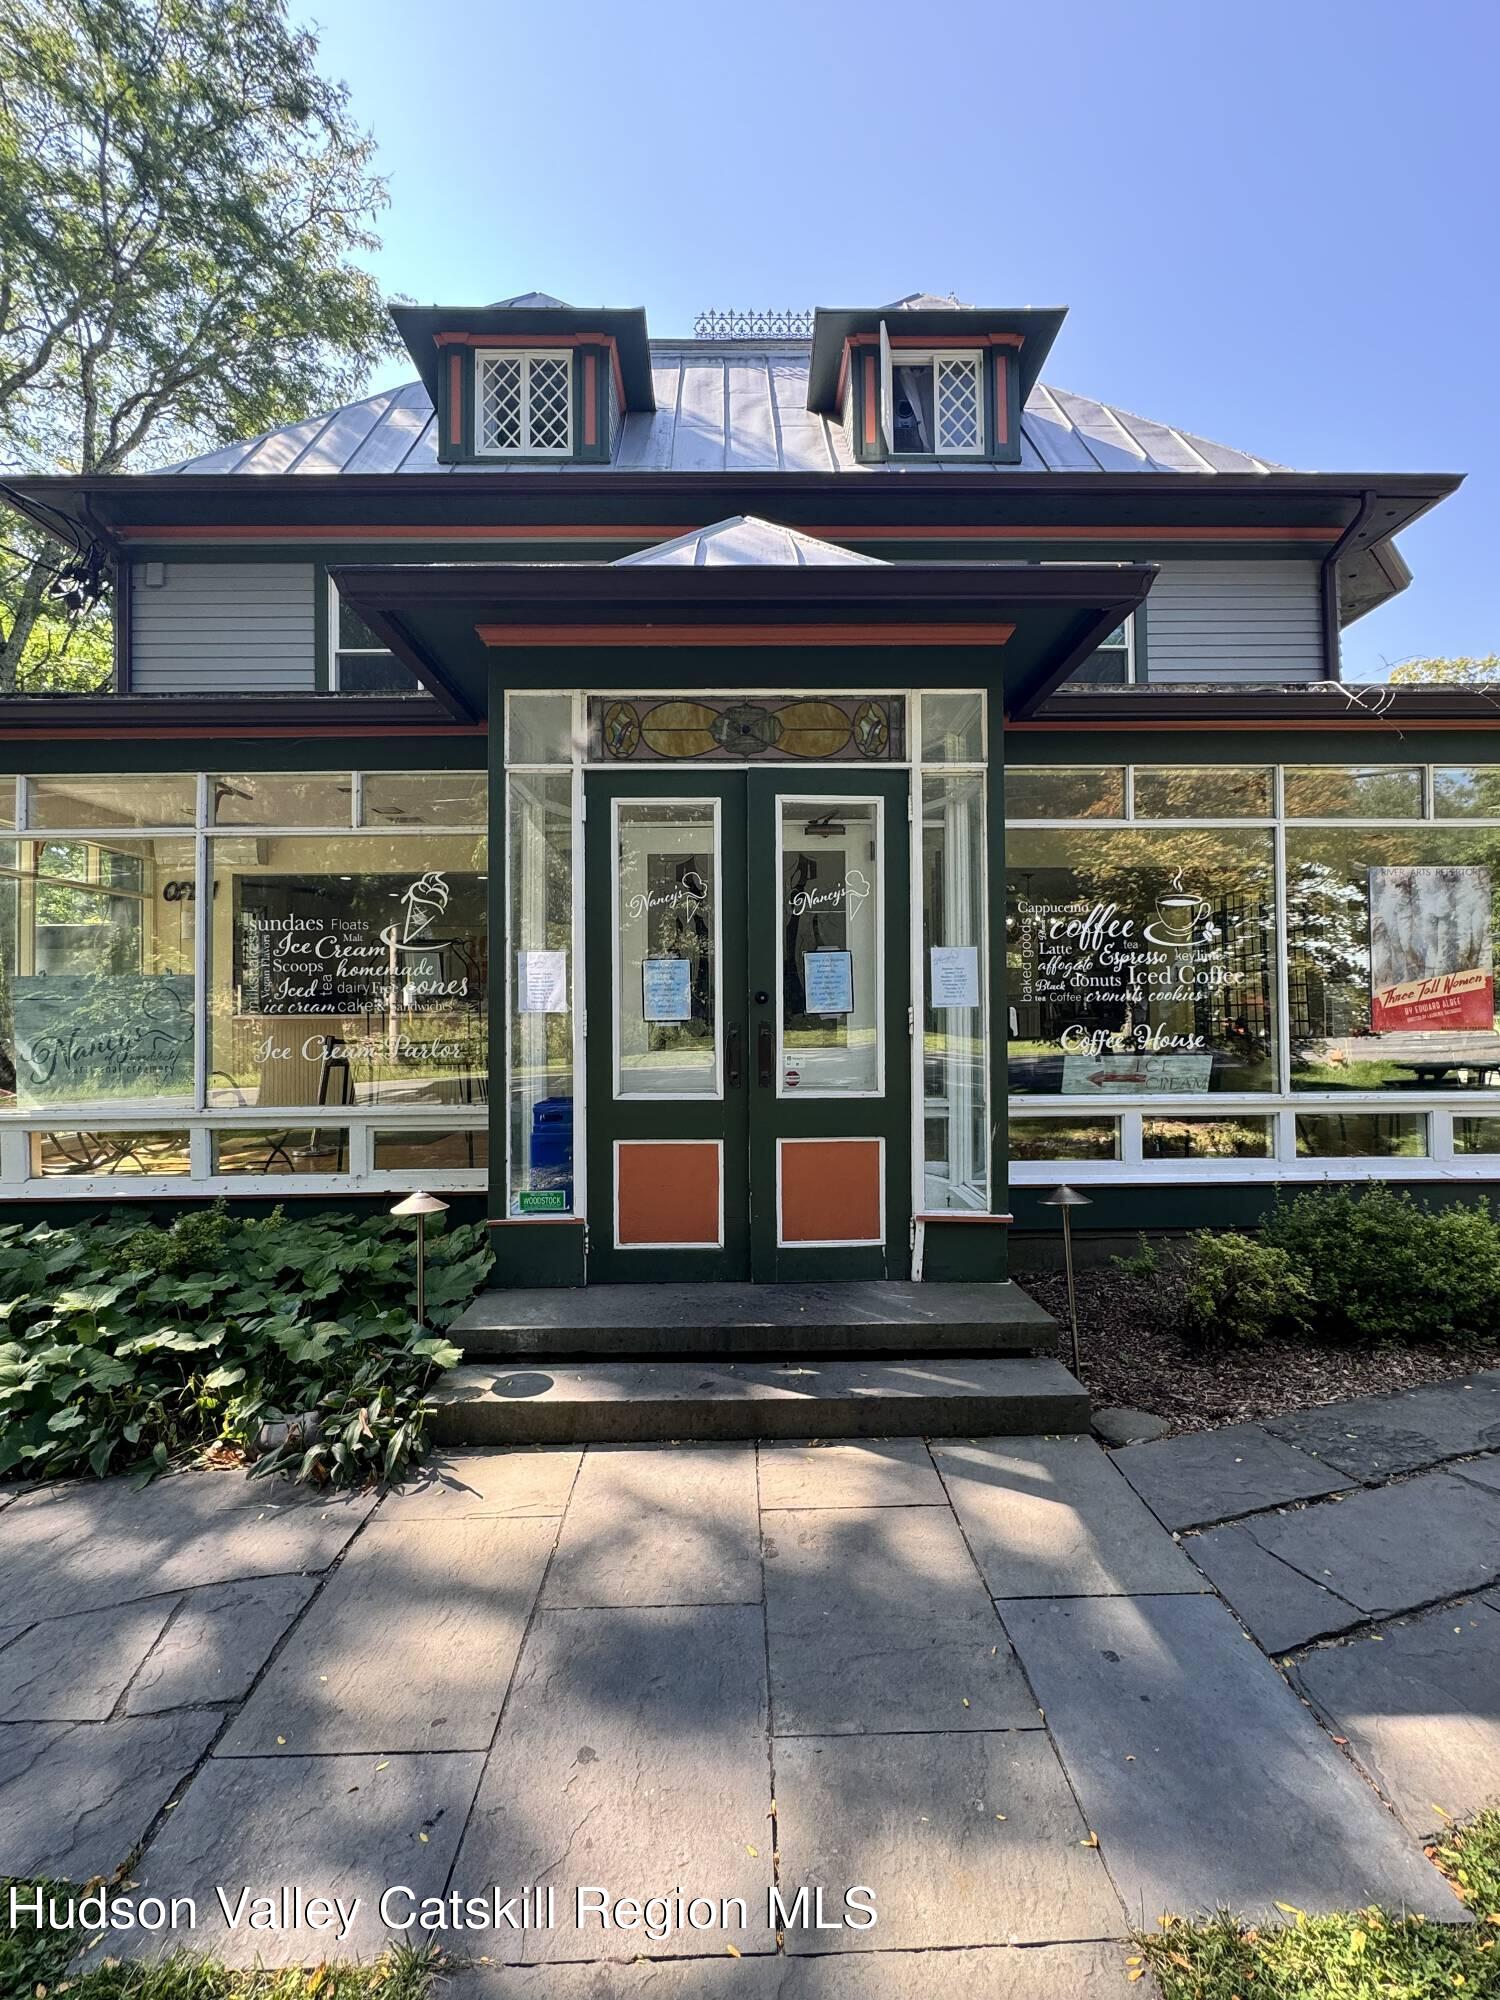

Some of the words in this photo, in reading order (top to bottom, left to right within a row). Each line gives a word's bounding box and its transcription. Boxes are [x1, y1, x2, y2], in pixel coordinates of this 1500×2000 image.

[1411, 867, 1431, 877] ARTS
[625, 885, 683, 918] Nancy's
[789, 883, 846, 916] Nancy's
[1017, 901, 1089, 916] Cappuccino
[249, 913, 324, 931] sundaes
[331, 918, 369, 931] Floats
[1050, 903, 1134, 951] coffee
[273, 931, 312, 957] Ice
[315, 935, 386, 959] Cream
[343, 933, 363, 942] Malt
[1020, 917, 1034, 958] goods
[1123, 940, 1139, 949] tea
[261, 934, 270, 967] Flavors
[1040, 942, 1072, 955] Latte
[1099, 943, 1167, 972] Espresso
[1174, 949, 1194, 964] key
[246, 935, 259, 1014] milkshakes
[273, 958, 324, 976] Scoops
[336, 957, 434, 978] homemade
[1038, 955, 1093, 978] affogato
[1127, 965, 1172, 985] Iced
[1178, 965, 1245, 985] Coffee
[261, 970, 271, 999] Vegan
[274, 977, 319, 1000] Iced
[320, 974, 333, 996] tea
[337, 981, 370, 996] dairy
[402, 977, 468, 997] cones
[1020, 962, 1032, 1002] baked
[1035, 978, 1065, 991] Black
[1070, 972, 1122, 987] donuts
[1382, 987, 1415, 1007] Three
[1417, 978, 1441, 1001] Tall
[1443, 972, 1482, 994] Women
[1049, 992, 1082, 1002] Coffee
[1148, 985, 1202, 1002] cookies
[263, 999, 284, 1014] ice
[288, 1001, 335, 1014] cream
[254, 1035, 293, 1063] Ice
[302, 1034, 377, 1062] Cream
[384, 1034, 463, 1061] Parlor
[1061, 1024, 1125, 1056] Coffee
[1134, 1022, 1206, 1050] House
[20, 1016, 141, 1085] Nancy's
[1136, 1059, 1172, 1073] ICE
[1145, 1077, 1208, 1090] CREAM
[523, 1197, 562, 1205] WOODSTOCK
